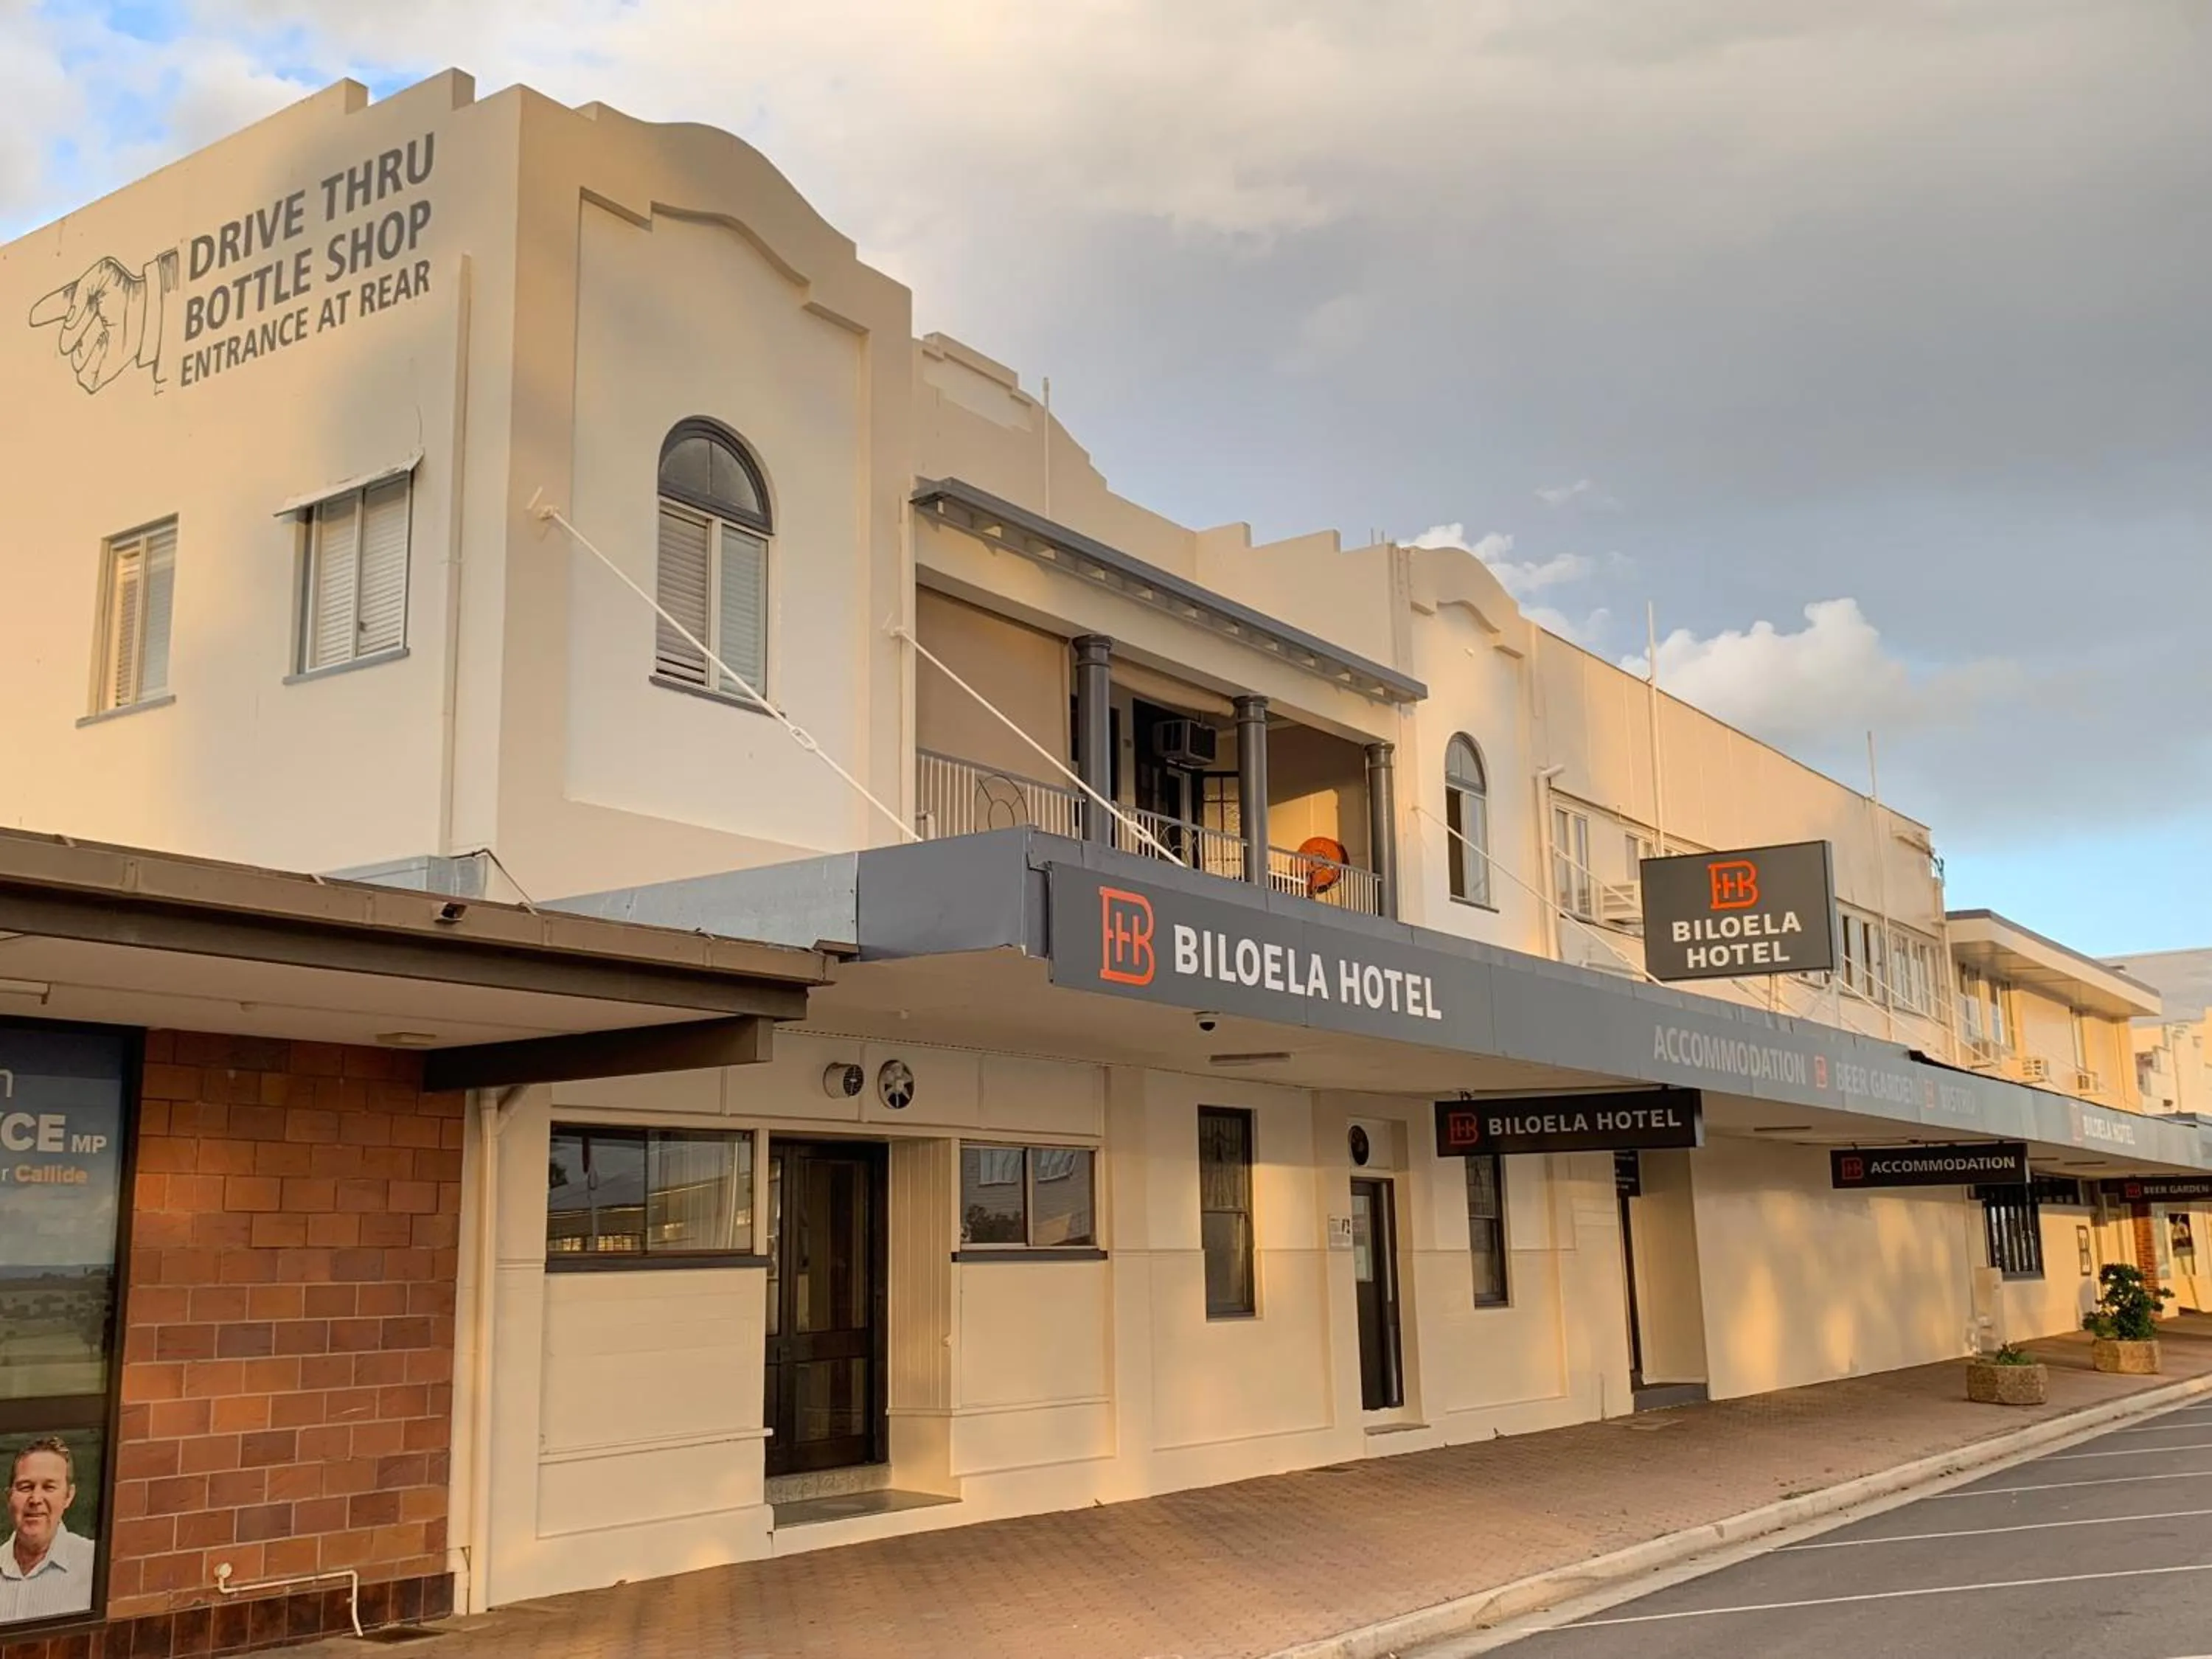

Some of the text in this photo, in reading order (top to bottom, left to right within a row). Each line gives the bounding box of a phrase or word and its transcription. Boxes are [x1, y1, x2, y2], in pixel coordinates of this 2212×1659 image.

[189, 131, 435, 282] DRIVE THRU
[184, 199, 431, 342] BOTTLE SHOP
[180, 258, 431, 388] ENTRANCE AT REAR
[1672, 911, 1802, 943] BILOELA
[1174, 924, 1443, 1020] BILOELA HOTEL
[1686, 940, 1790, 969] HOTEL
[1653, 1025, 1806, 1086] ACCOMMODATION
[1835, 1061, 1869, 1096] BEER
[0, 1112, 107, 1153] CE MP
[1488, 1109, 1683, 1136] BILOELA HOTEL
[15, 1164, 88, 1183] Callide
[1870, 1156, 2016, 1174] ACCOMMODATION
[2143, 1183, 2209, 1194] BEER GARDEN
